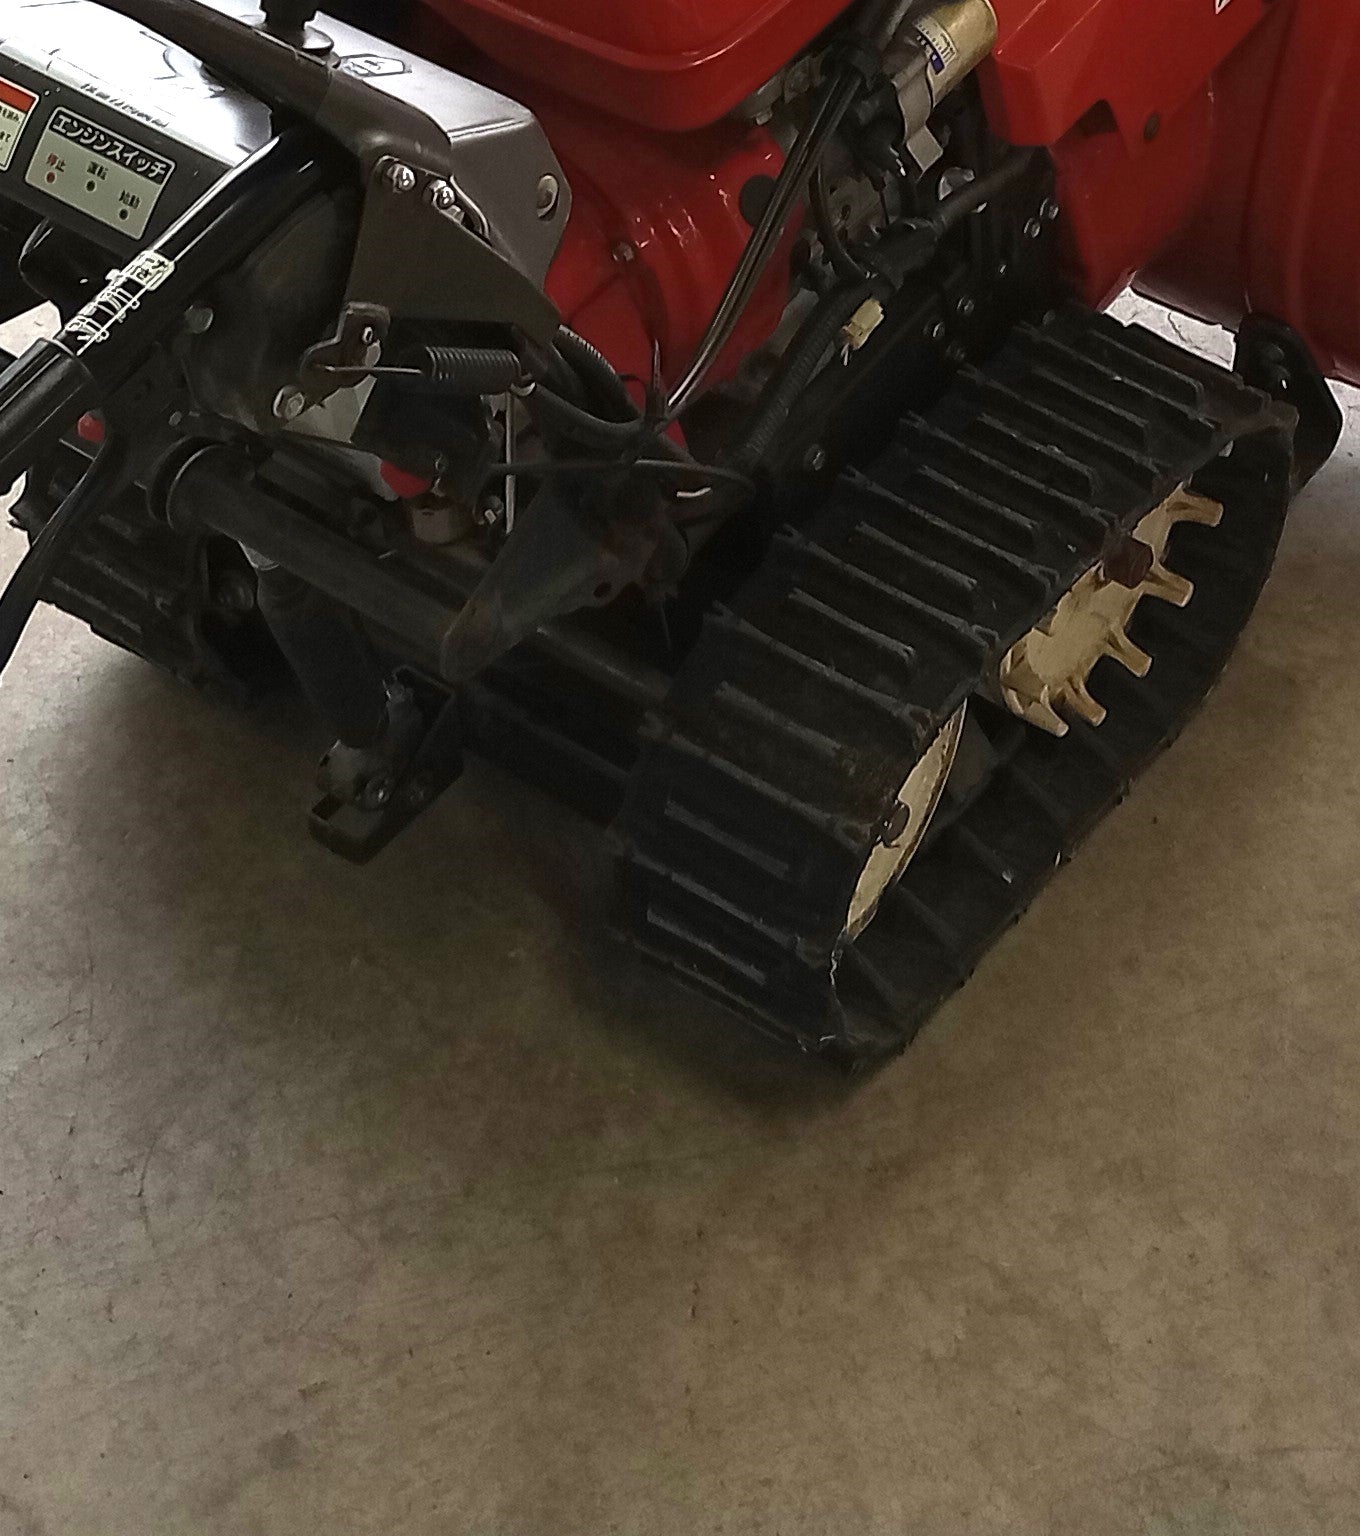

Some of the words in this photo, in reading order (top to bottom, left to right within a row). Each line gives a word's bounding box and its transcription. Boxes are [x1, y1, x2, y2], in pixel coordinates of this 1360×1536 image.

[52, 114, 167, 178] エンジンスイッチ
